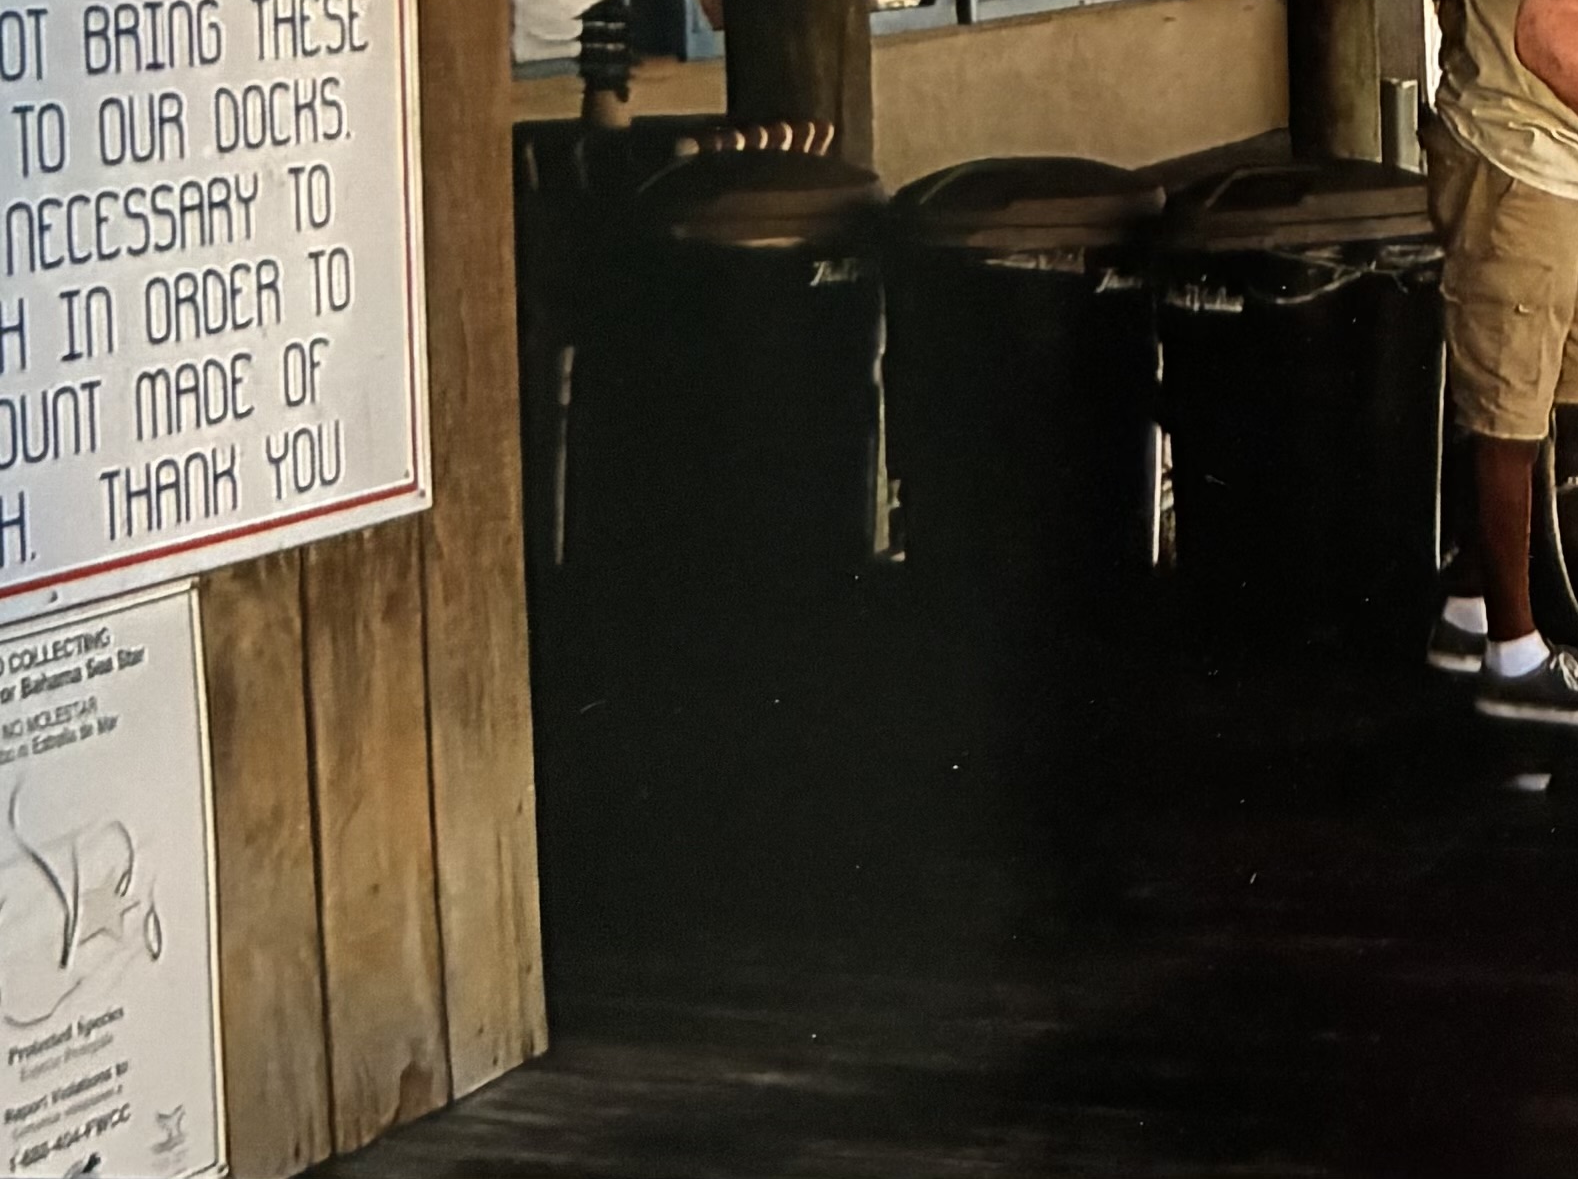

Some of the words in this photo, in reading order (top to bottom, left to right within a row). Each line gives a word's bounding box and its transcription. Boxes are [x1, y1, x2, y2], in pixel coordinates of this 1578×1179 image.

[0, 7, 48, 82] OT
[12, 103, 66, 178] TO
[99, 92, 186, 166] OUR
[214, 76, 352, 154] DOCKS.
[6, 173, 258, 276] NECESSARY
[287, 164, 331, 233] TO
[60, 286, 113, 362] IN
[146, 258, 282, 347] ORDER
[308, 247, 352, 317] TO
[136, 353, 254, 441] MADE
[284, 337, 329, 408] OF
[99, 443, 239, 542] THANK
[266, 418, 343, 500] YOU
[8, 626, 112, 675] COLLECTING
